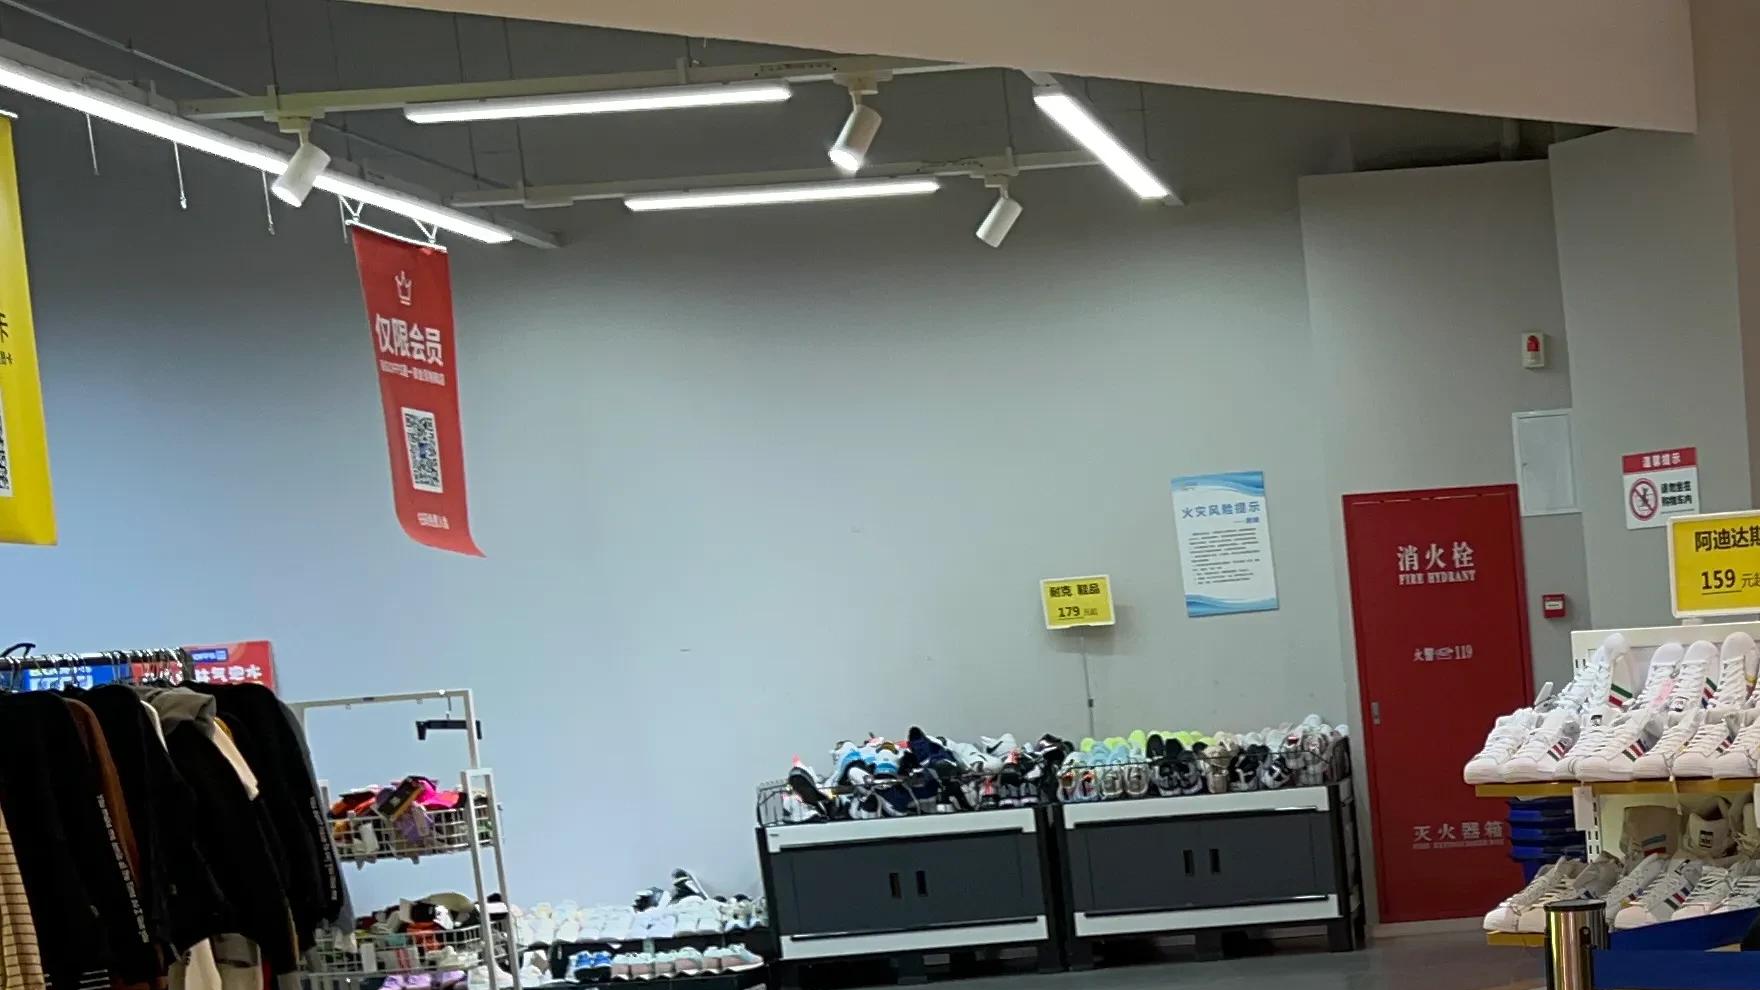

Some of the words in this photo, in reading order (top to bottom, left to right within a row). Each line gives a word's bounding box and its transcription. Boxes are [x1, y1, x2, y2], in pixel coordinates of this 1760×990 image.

[375, 312, 444, 367] 仅限会员
[1181, 501, 1260, 519] 火灾风险提示
[1397, 541, 1475, 572] 消火栓
[1398, 573, 1425, 585] FIRE
[1427, 569, 1476, 584] HYDRANT
[1701, 568, 1736, 590] 159
[1058, 606, 1080, 618] 179
[1455, 644, 1473, 660] 119
[1413, 821, 1504, 842] 灭火器箱
